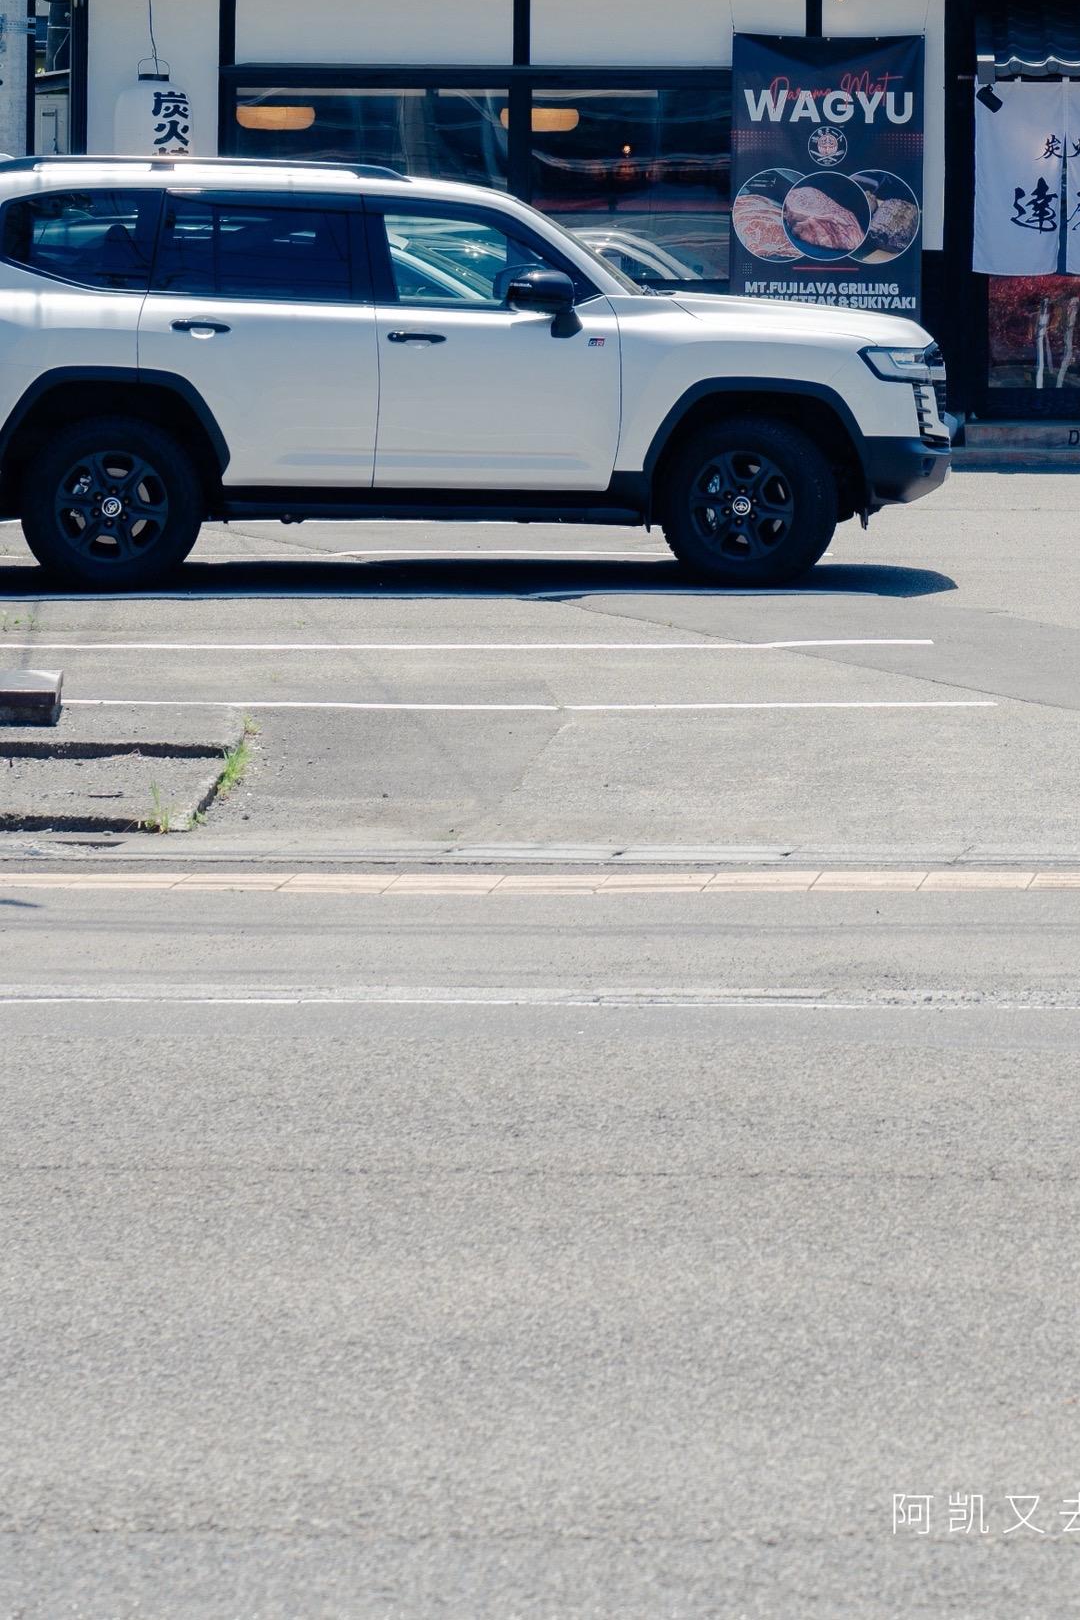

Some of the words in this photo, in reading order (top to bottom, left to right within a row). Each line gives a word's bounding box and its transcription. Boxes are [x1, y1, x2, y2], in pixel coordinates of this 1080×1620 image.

[743, 89, 914, 124] WAGYU
[152, 91, 190, 156] 炭火
[744, 281, 798, 294] MT.FUJI
[800, 282, 837, 295] LAVA
[838, 282, 899, 296] GRILLING
[850, 296, 916, 309] SUKIYAKI
[589, 338, 605, 347] GR
